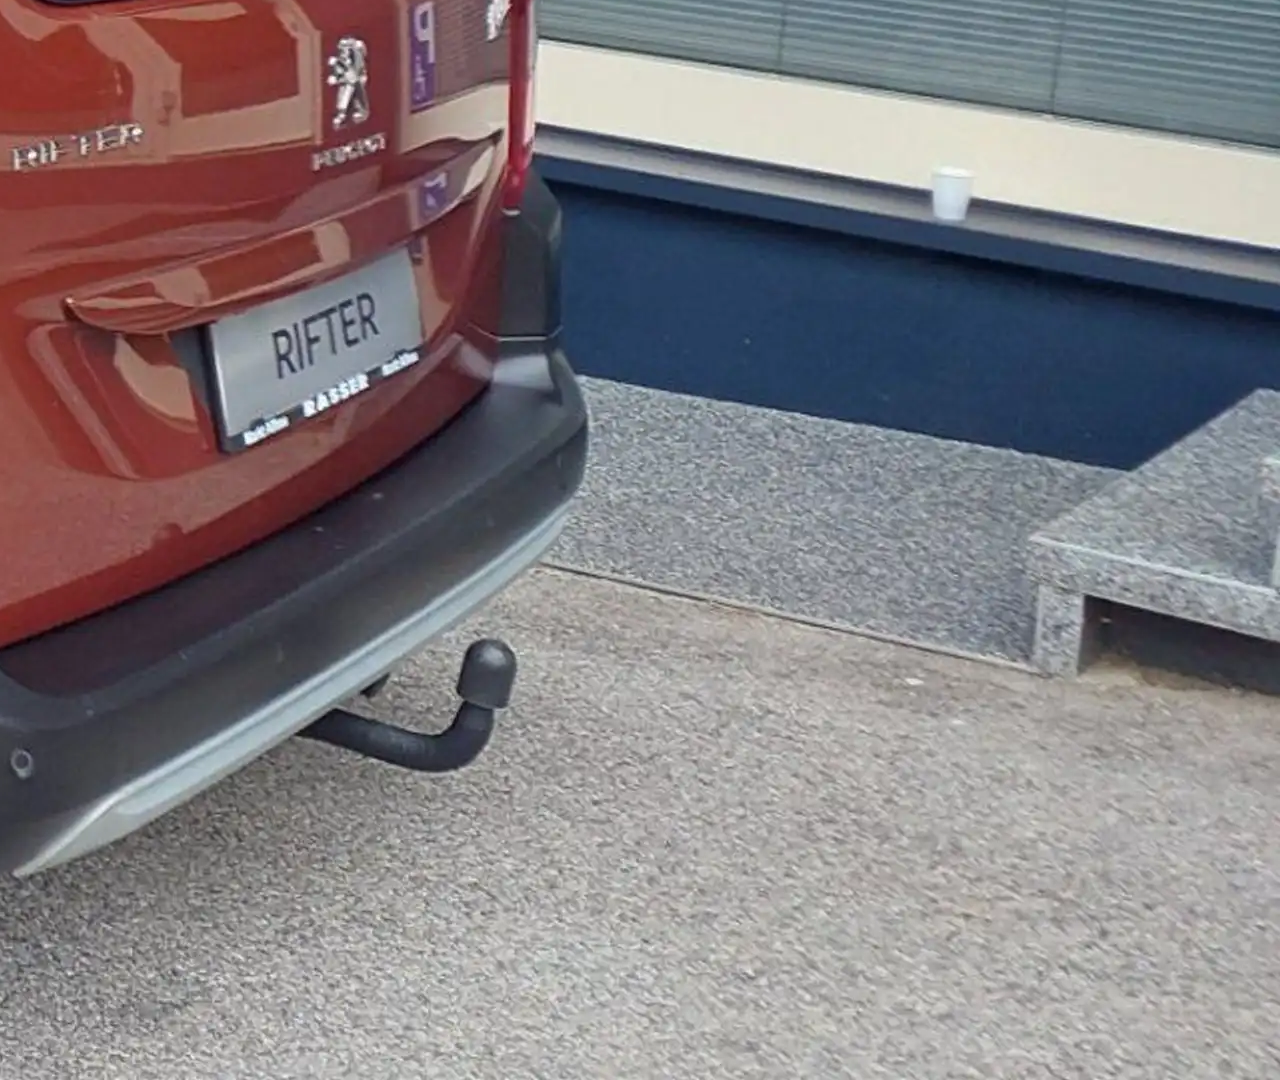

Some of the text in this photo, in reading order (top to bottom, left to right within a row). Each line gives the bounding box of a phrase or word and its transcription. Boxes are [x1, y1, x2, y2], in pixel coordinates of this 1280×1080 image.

[12, 123, 143, 172] RIFTER
[272, 292, 380, 380] RIFTER
[302, 372, 371, 418] RASSER
